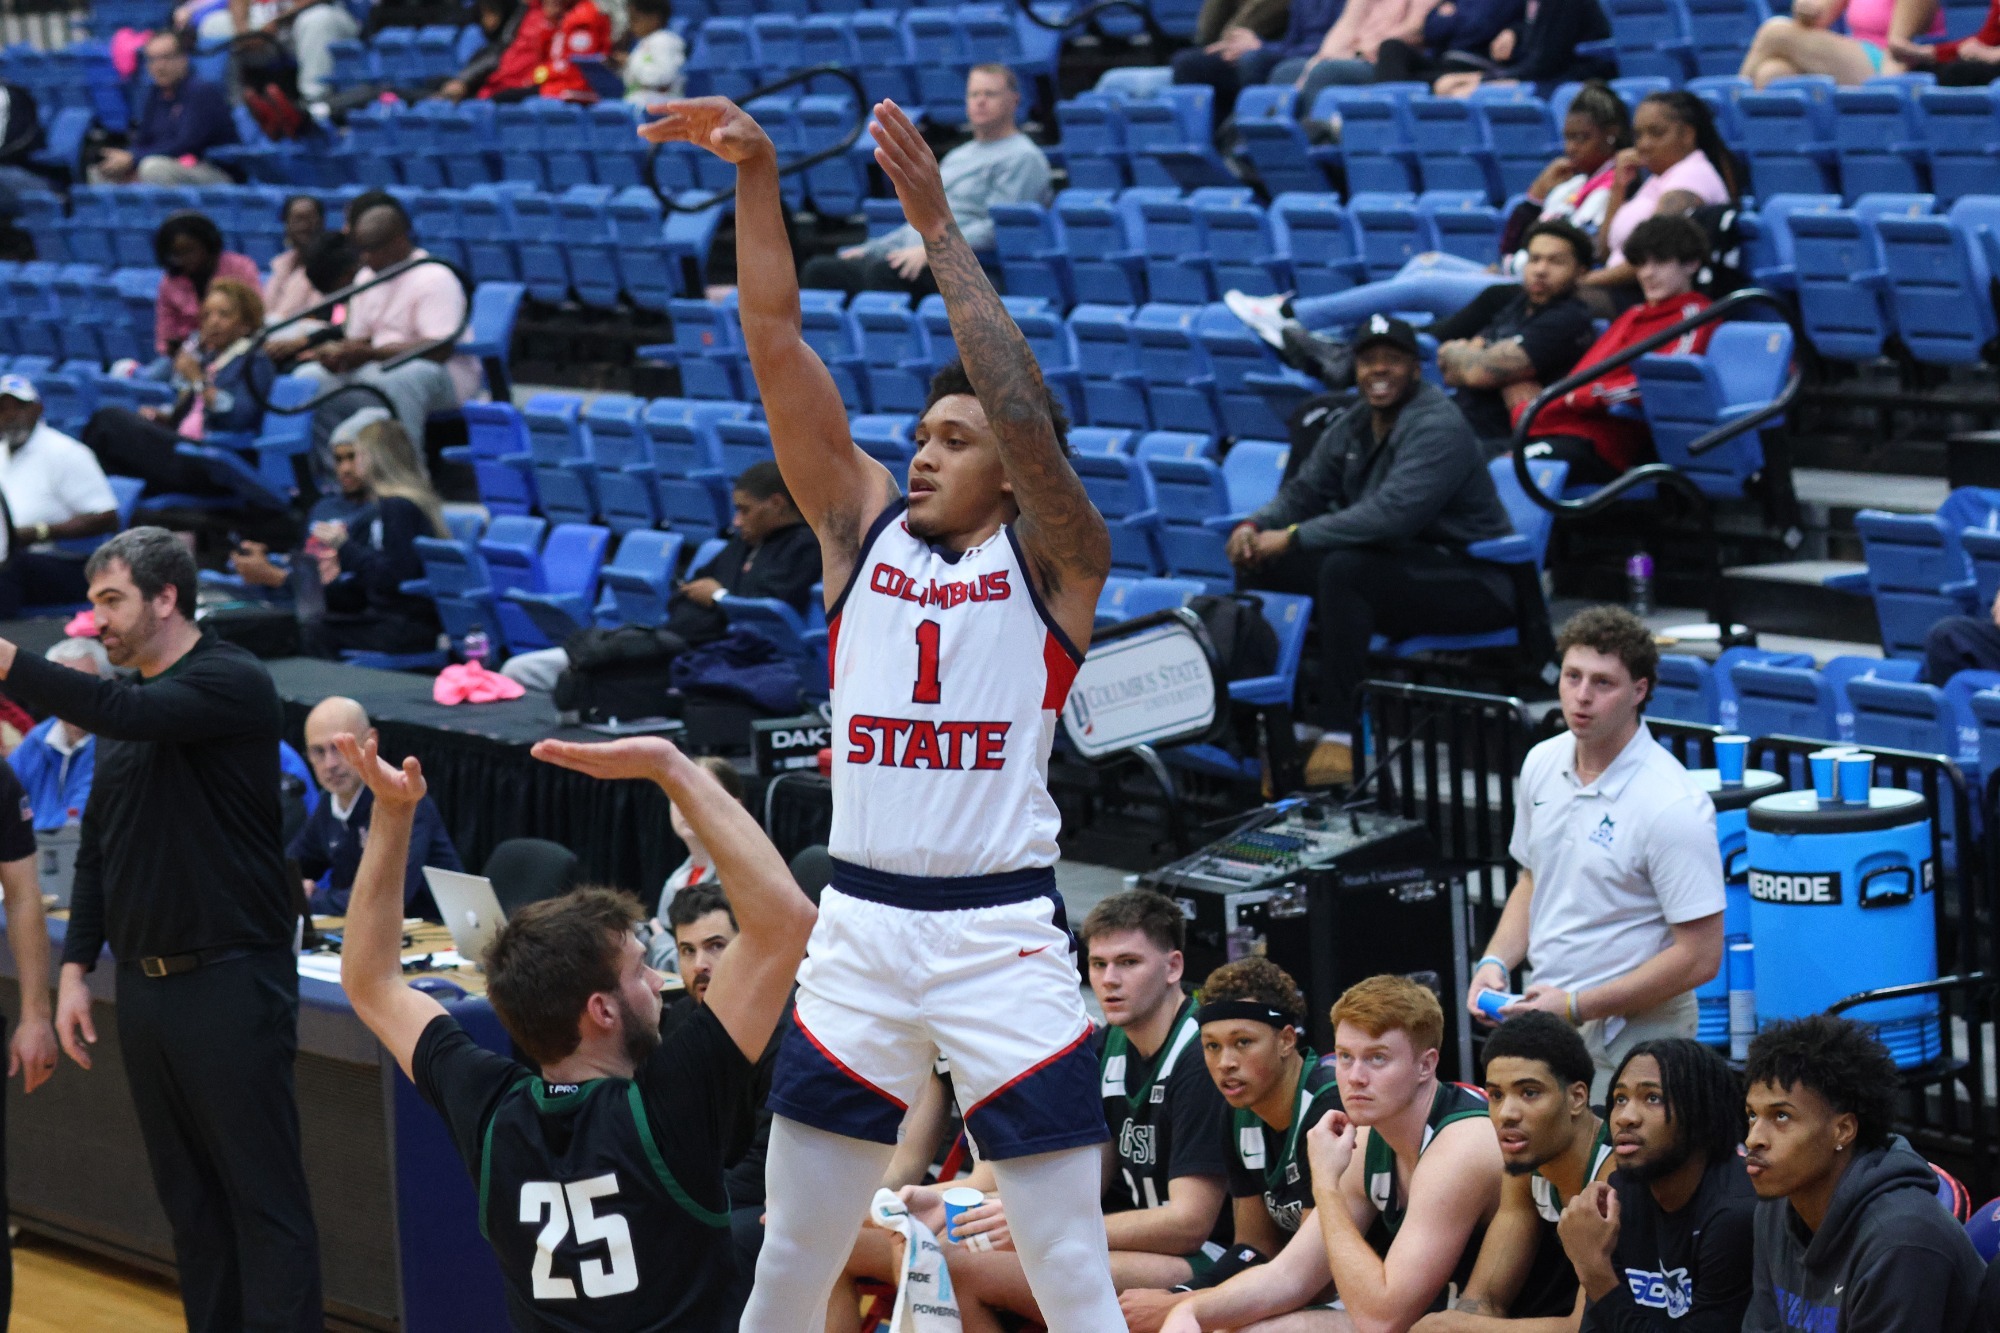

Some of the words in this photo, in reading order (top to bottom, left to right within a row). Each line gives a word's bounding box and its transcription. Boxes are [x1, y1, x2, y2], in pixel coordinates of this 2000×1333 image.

[870, 562, 1012, 610] COLMBUS
[912, 619, 941, 704] 1
[847, 714, 1012, 771] STATE
[555, 1084, 578, 1093] PRO
[519, 1172, 639, 1299] 25
